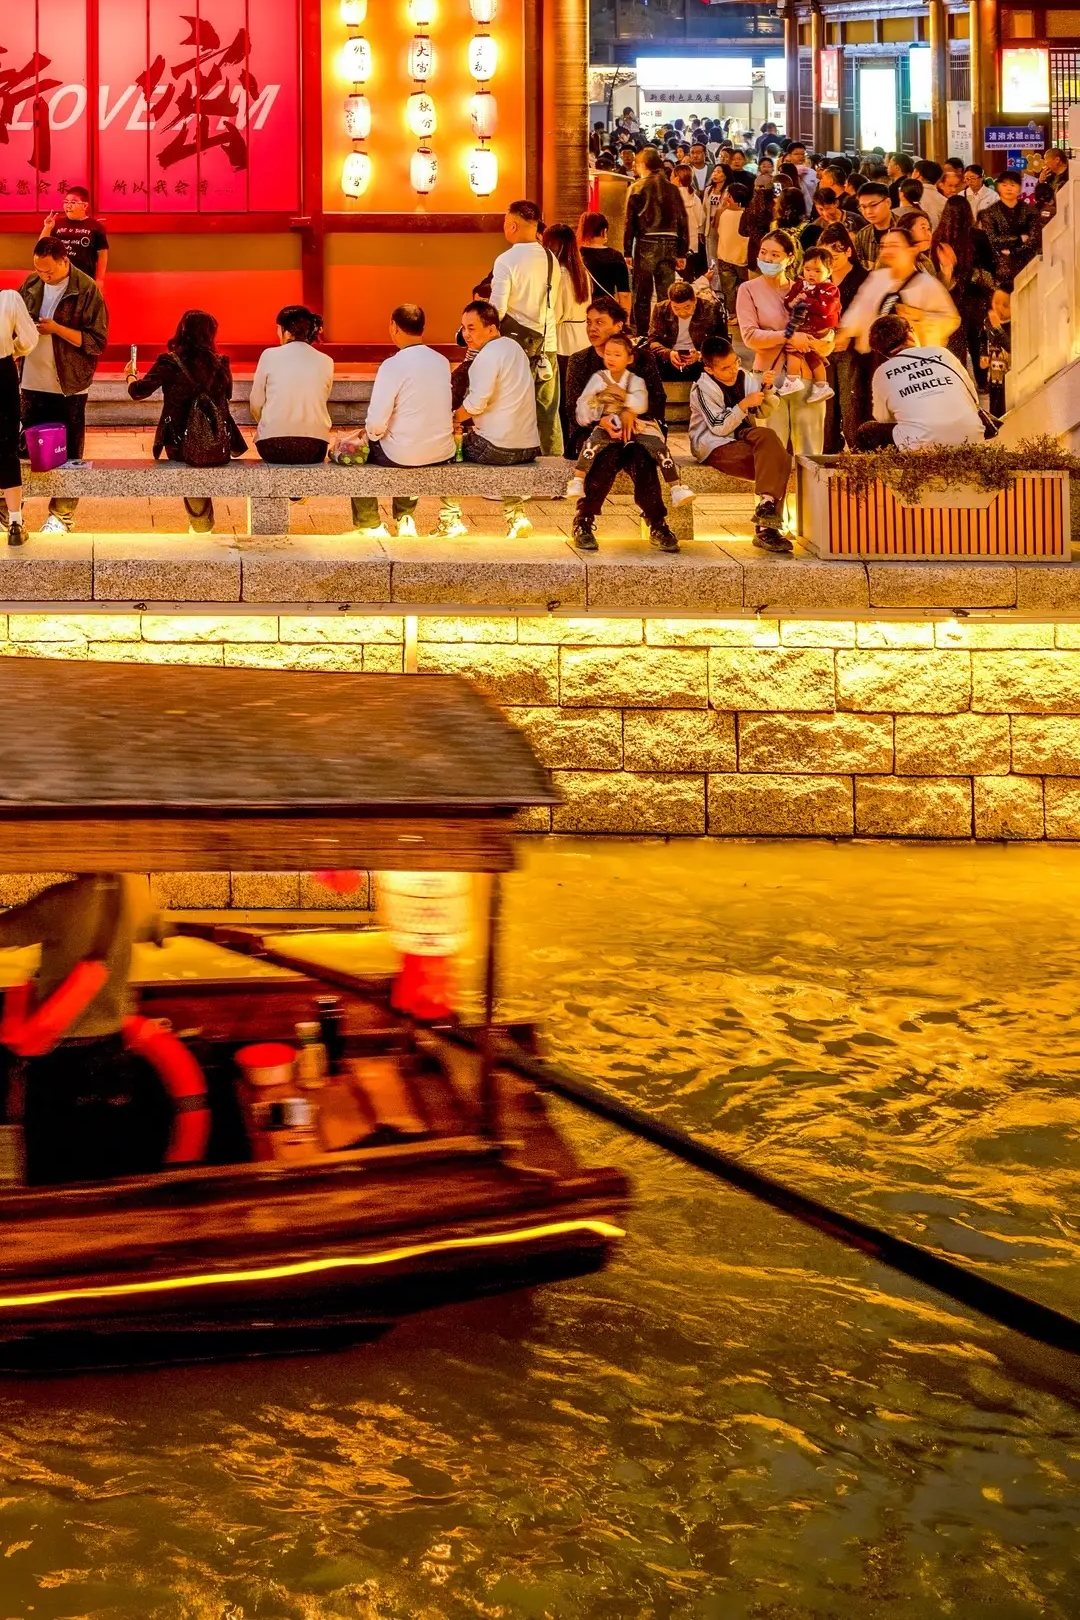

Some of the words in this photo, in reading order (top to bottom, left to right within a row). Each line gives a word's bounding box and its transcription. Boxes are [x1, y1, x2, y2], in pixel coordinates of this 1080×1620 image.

[885, 354, 943, 380] FANTASY
[908, 367, 934, 382] AND
[898, 376, 954, 398] MIRACLE
